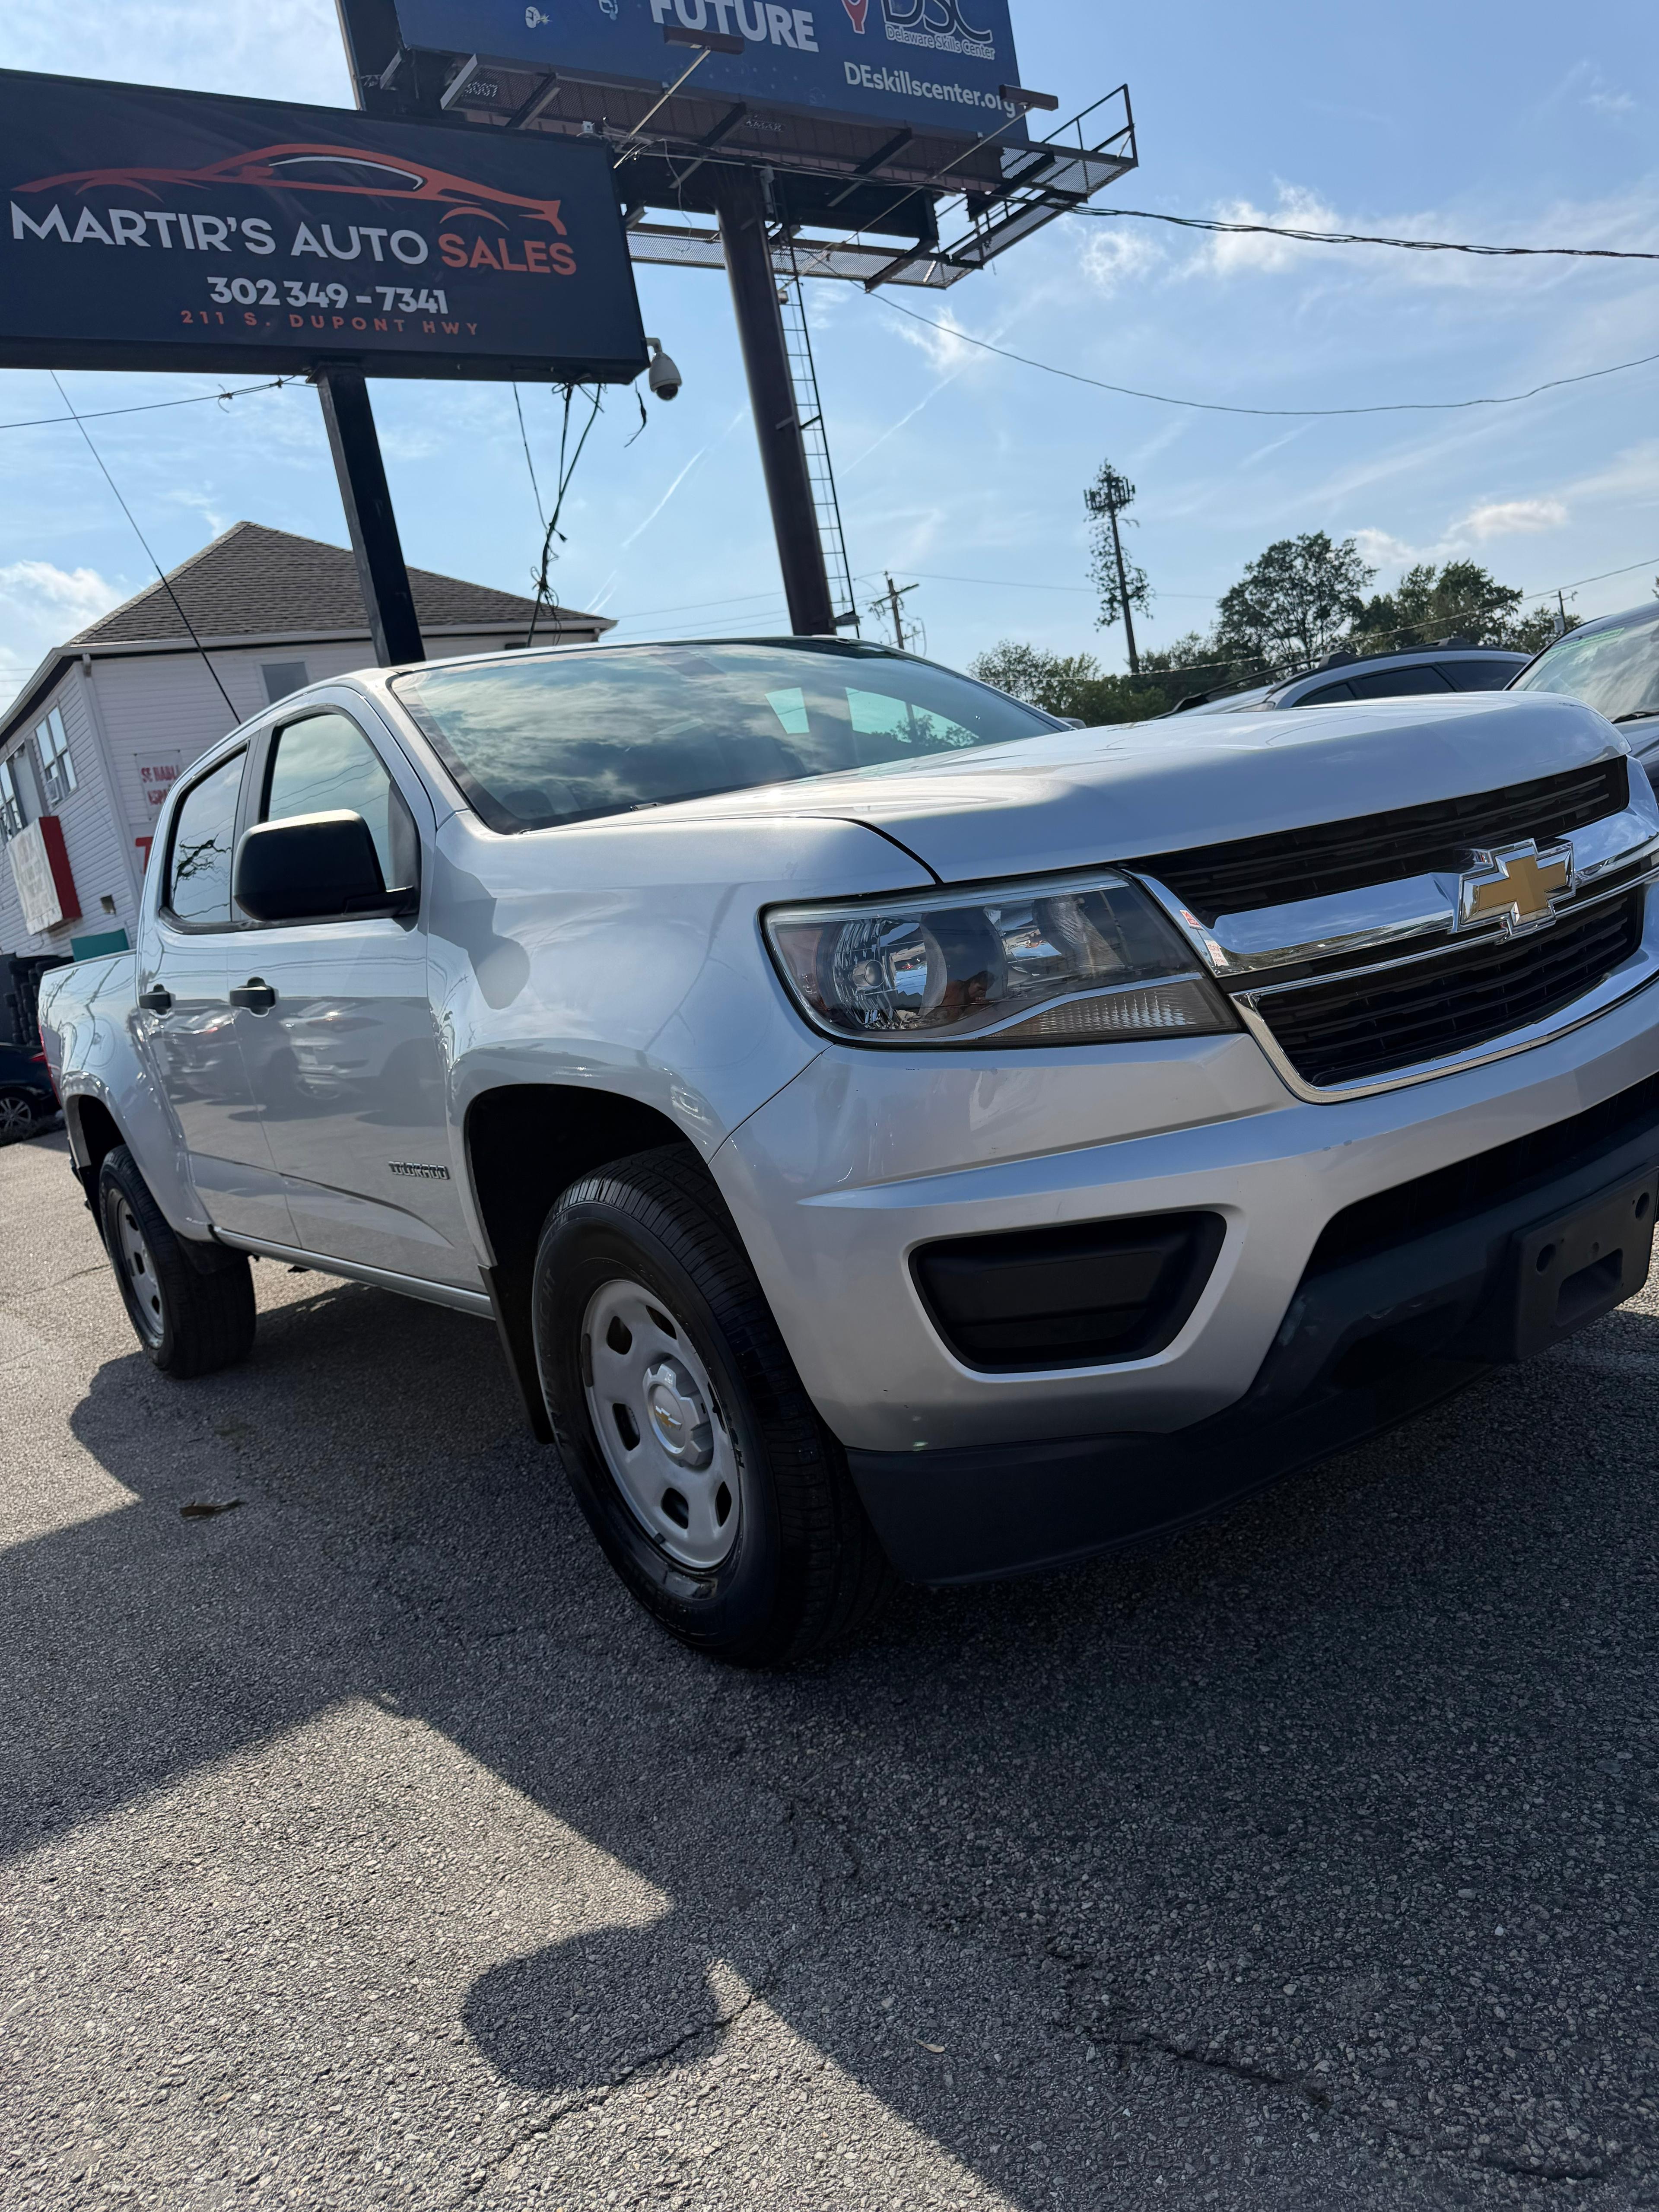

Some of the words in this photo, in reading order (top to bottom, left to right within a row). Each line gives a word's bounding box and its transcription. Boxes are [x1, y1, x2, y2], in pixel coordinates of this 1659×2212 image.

[650, 0, 819, 52] FUTURE
[885, 24, 935, 48] Delaware
[934, 34, 962, 54] Skills
[962, 39, 995, 60] Center
[844, 61, 1016, 118] DEskillscenter.org
[10, 200, 276, 255] MARTIR'S
[290, 221, 429, 265] AUTO
[438, 233, 577, 275] SALES
[207, 276, 280, 305] 302
[181, 310, 225, 324] 211
[289, 314, 405, 332] DUPONT
[422, 321, 477, 336] HWY
